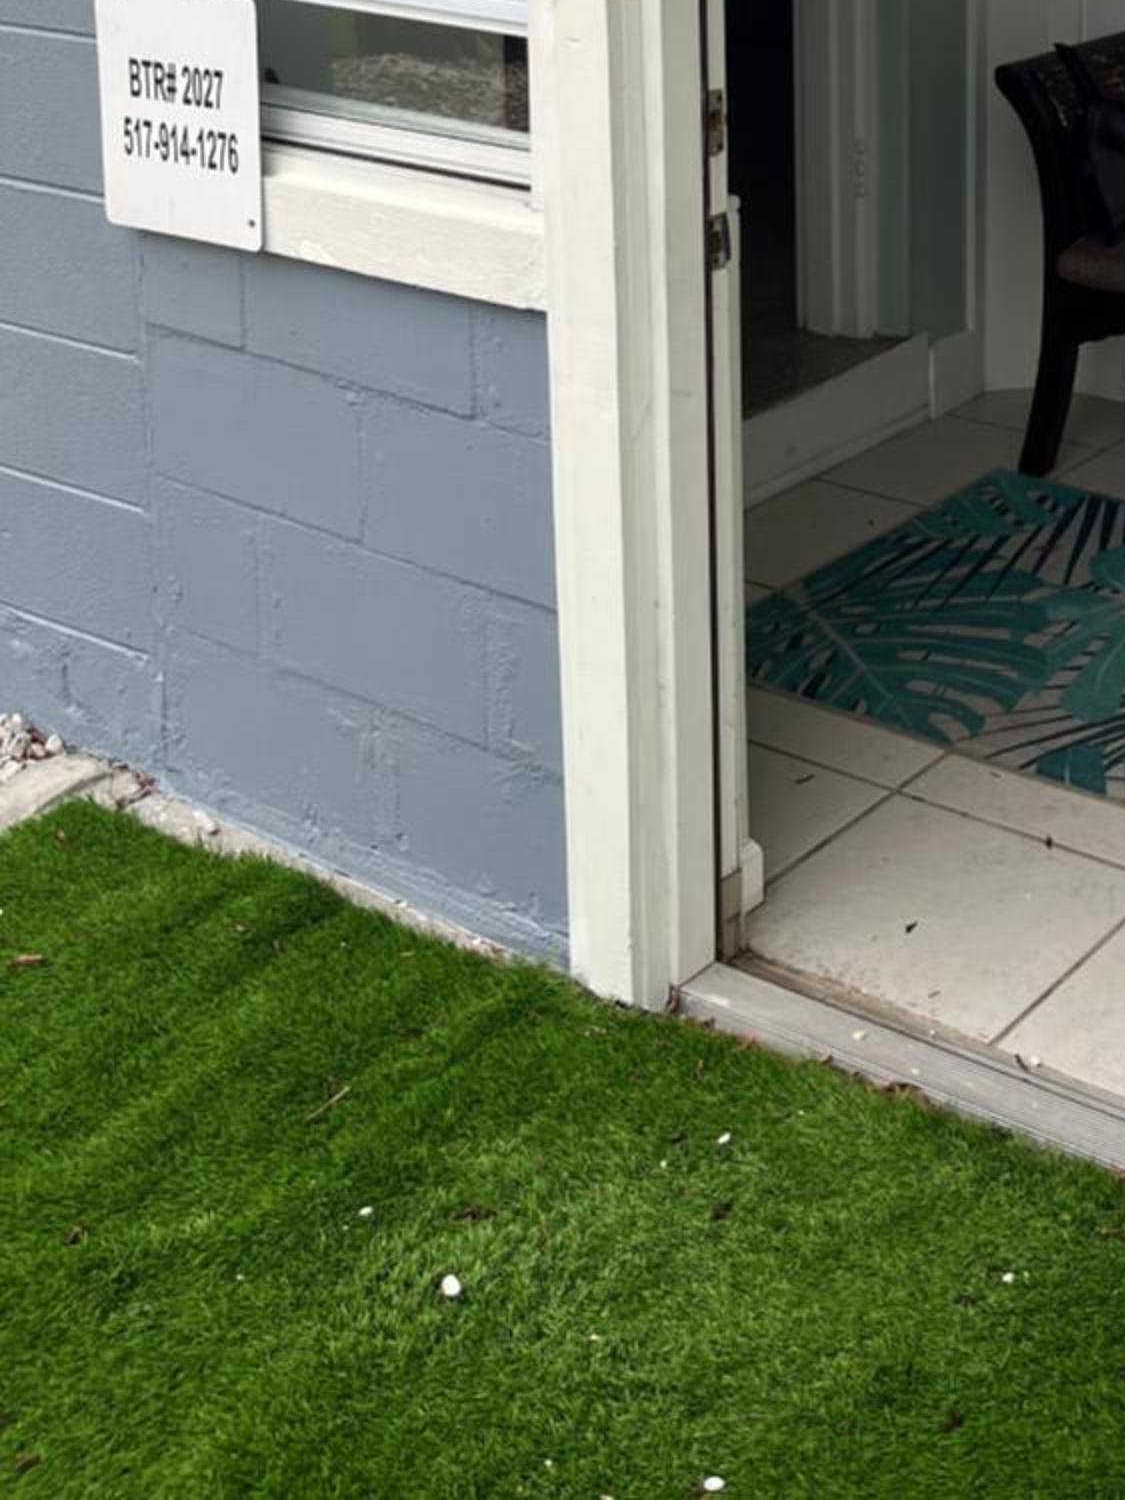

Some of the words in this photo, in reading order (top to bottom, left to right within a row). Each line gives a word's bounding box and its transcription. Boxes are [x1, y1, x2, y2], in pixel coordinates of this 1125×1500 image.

[128, 57, 177, 103] BTR#
[181, 65, 224, 110] 2027
[123, 116, 240, 175] 517-914-1276
